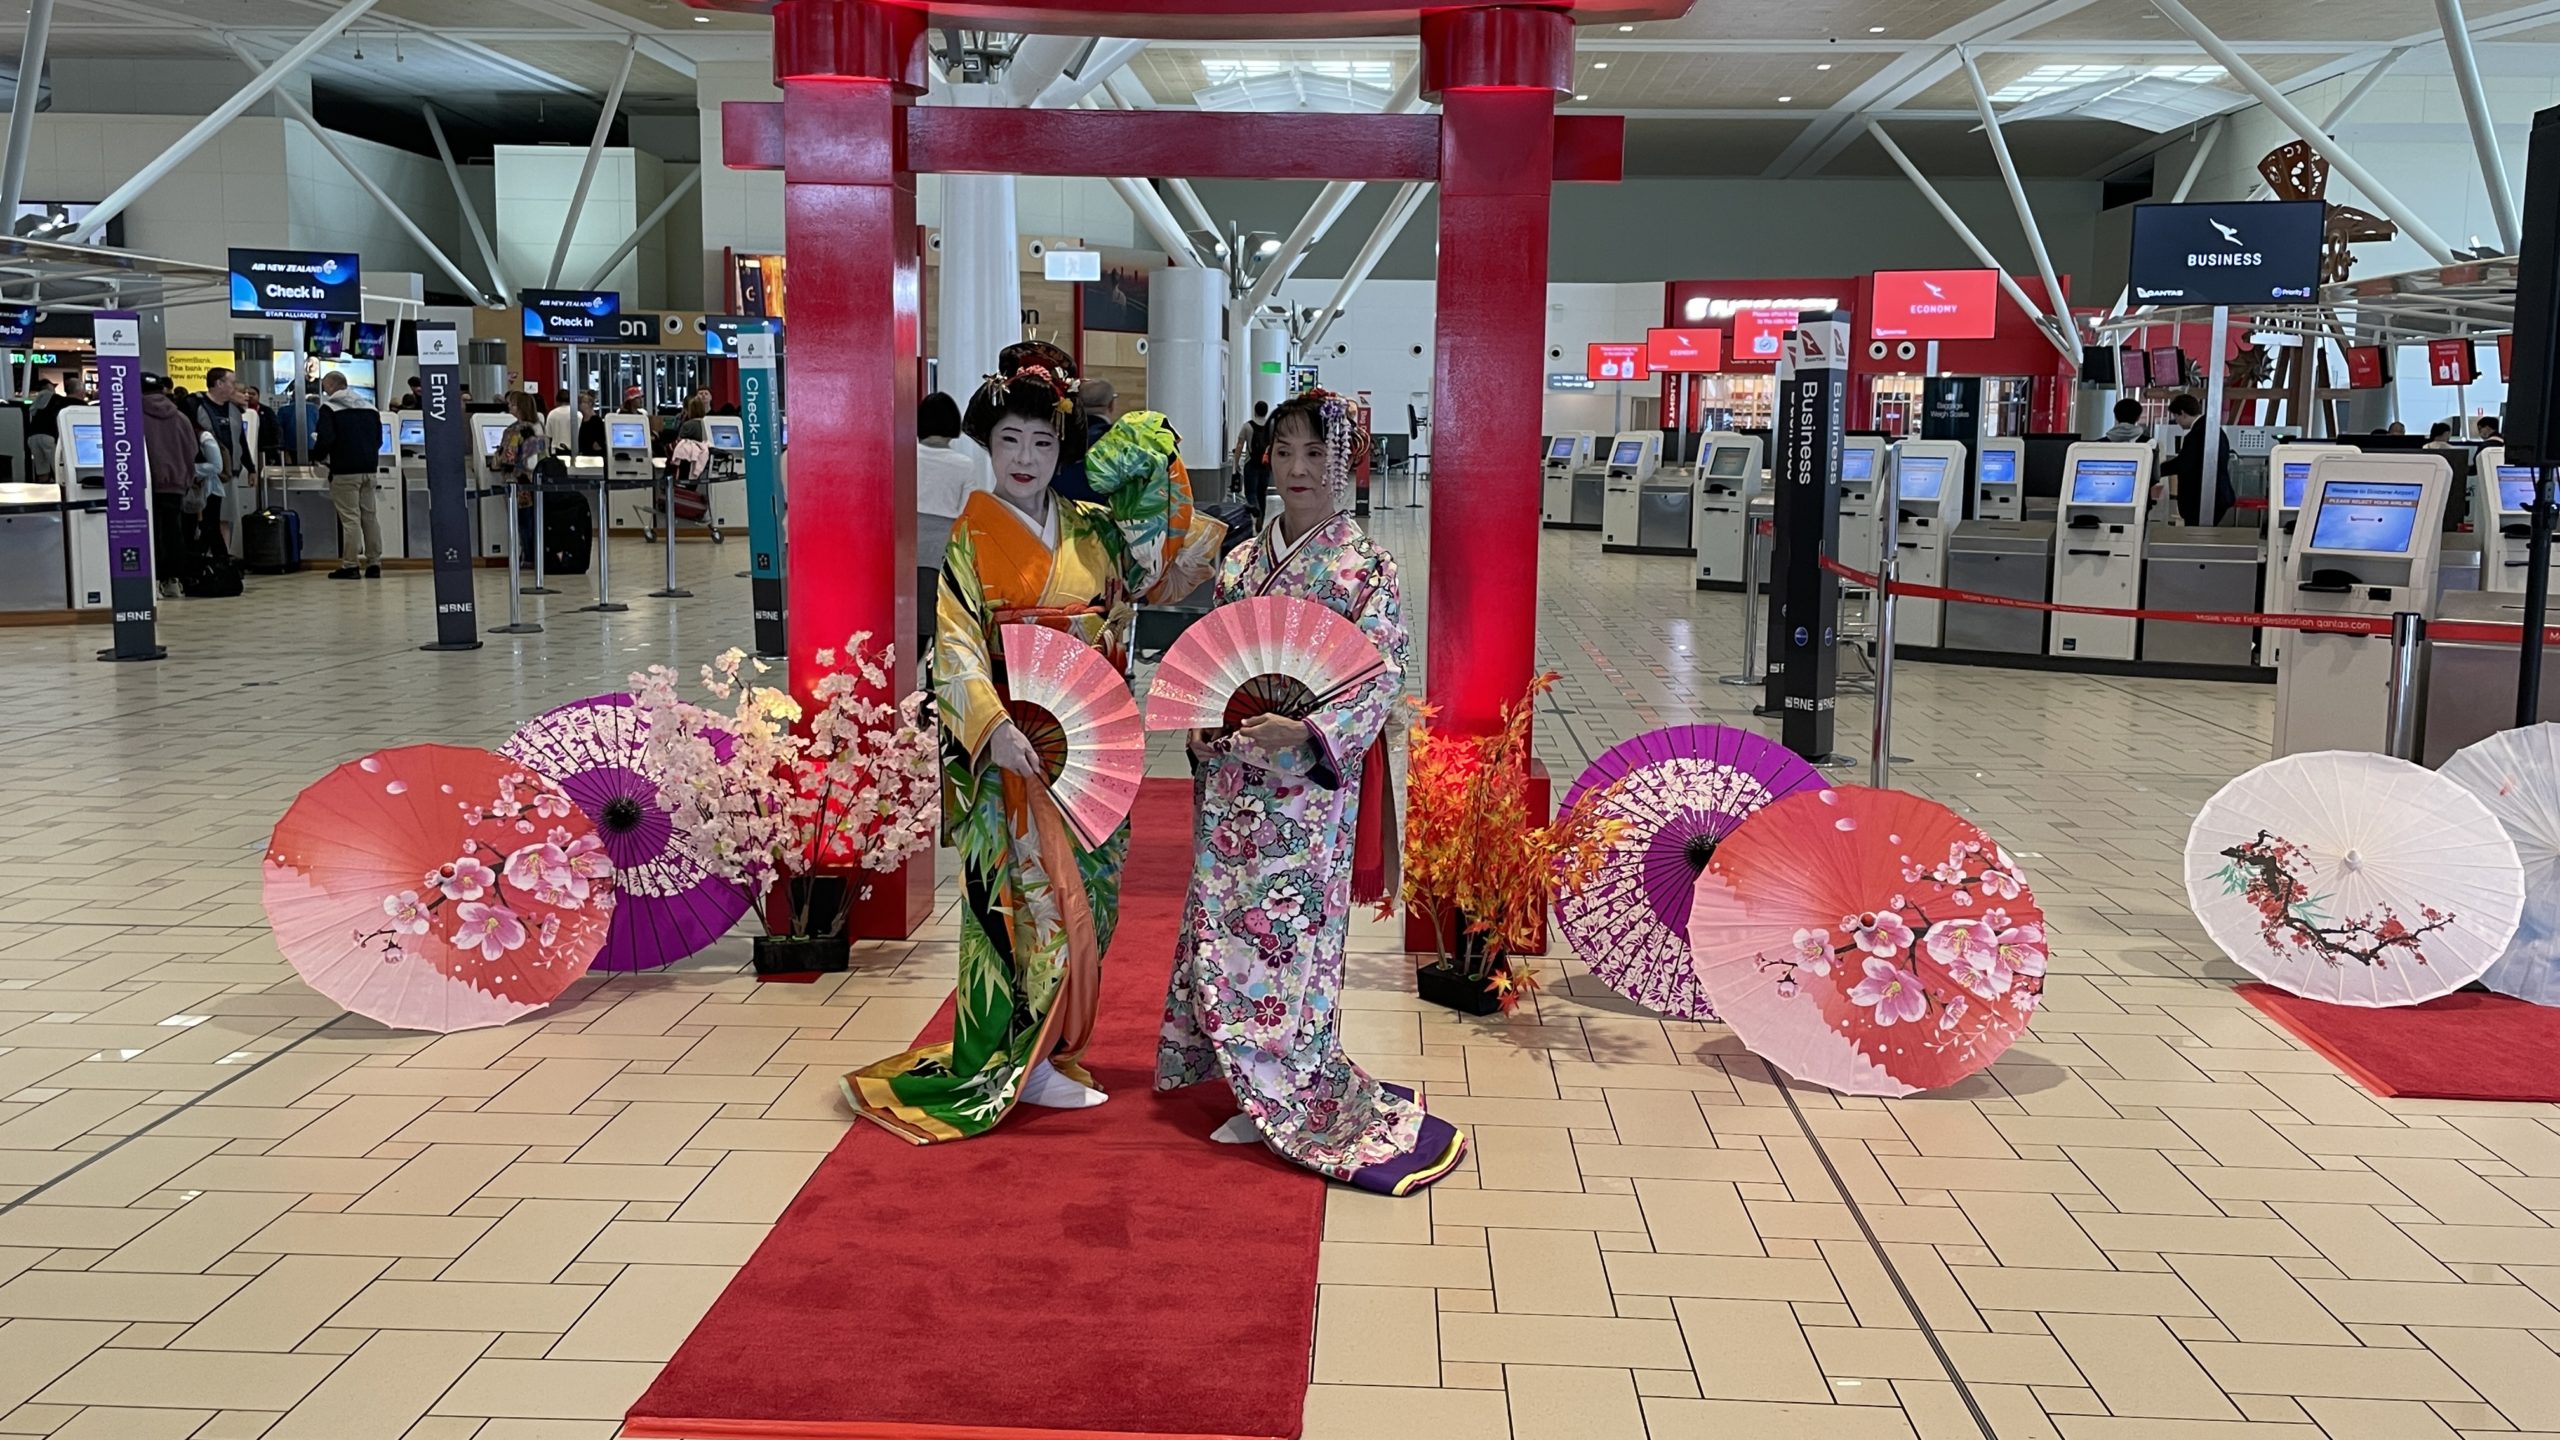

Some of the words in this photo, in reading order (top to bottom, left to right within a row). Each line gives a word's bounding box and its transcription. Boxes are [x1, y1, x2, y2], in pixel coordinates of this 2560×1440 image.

[2187, 253, 2262, 266] BUSINESS
[252, 263, 266, 271] AIR
[267, 264, 286, 272] NEW
[286, 264, 322, 273] ZEALAND
[266, 284, 310, 298] Check
[312, 286, 325, 299] in
[2147, 289, 2184, 297] QANTAS
[1910, 304, 1958, 314] ECONOMY
[550, 316, 582, 327] Check
[584, 317, 594, 328] in
[110, 365, 128, 436] Premium
[430, 374, 448, 421] Entry
[746, 377, 762, 456] Check-in
[1799, 382, 1818, 485] Business
[1830, 382, 1842, 485] Business
[115, 440, 133, 511] Check-in
[449, 602, 473, 613] BNE
[127, 611, 151, 621] BNE
[2243, 615, 2261, 624] first
[2262, 617, 2314, 627] destination
[2316, 620, 2371, 630] qantas.com
[1793, 697, 1814, 711] BNE
